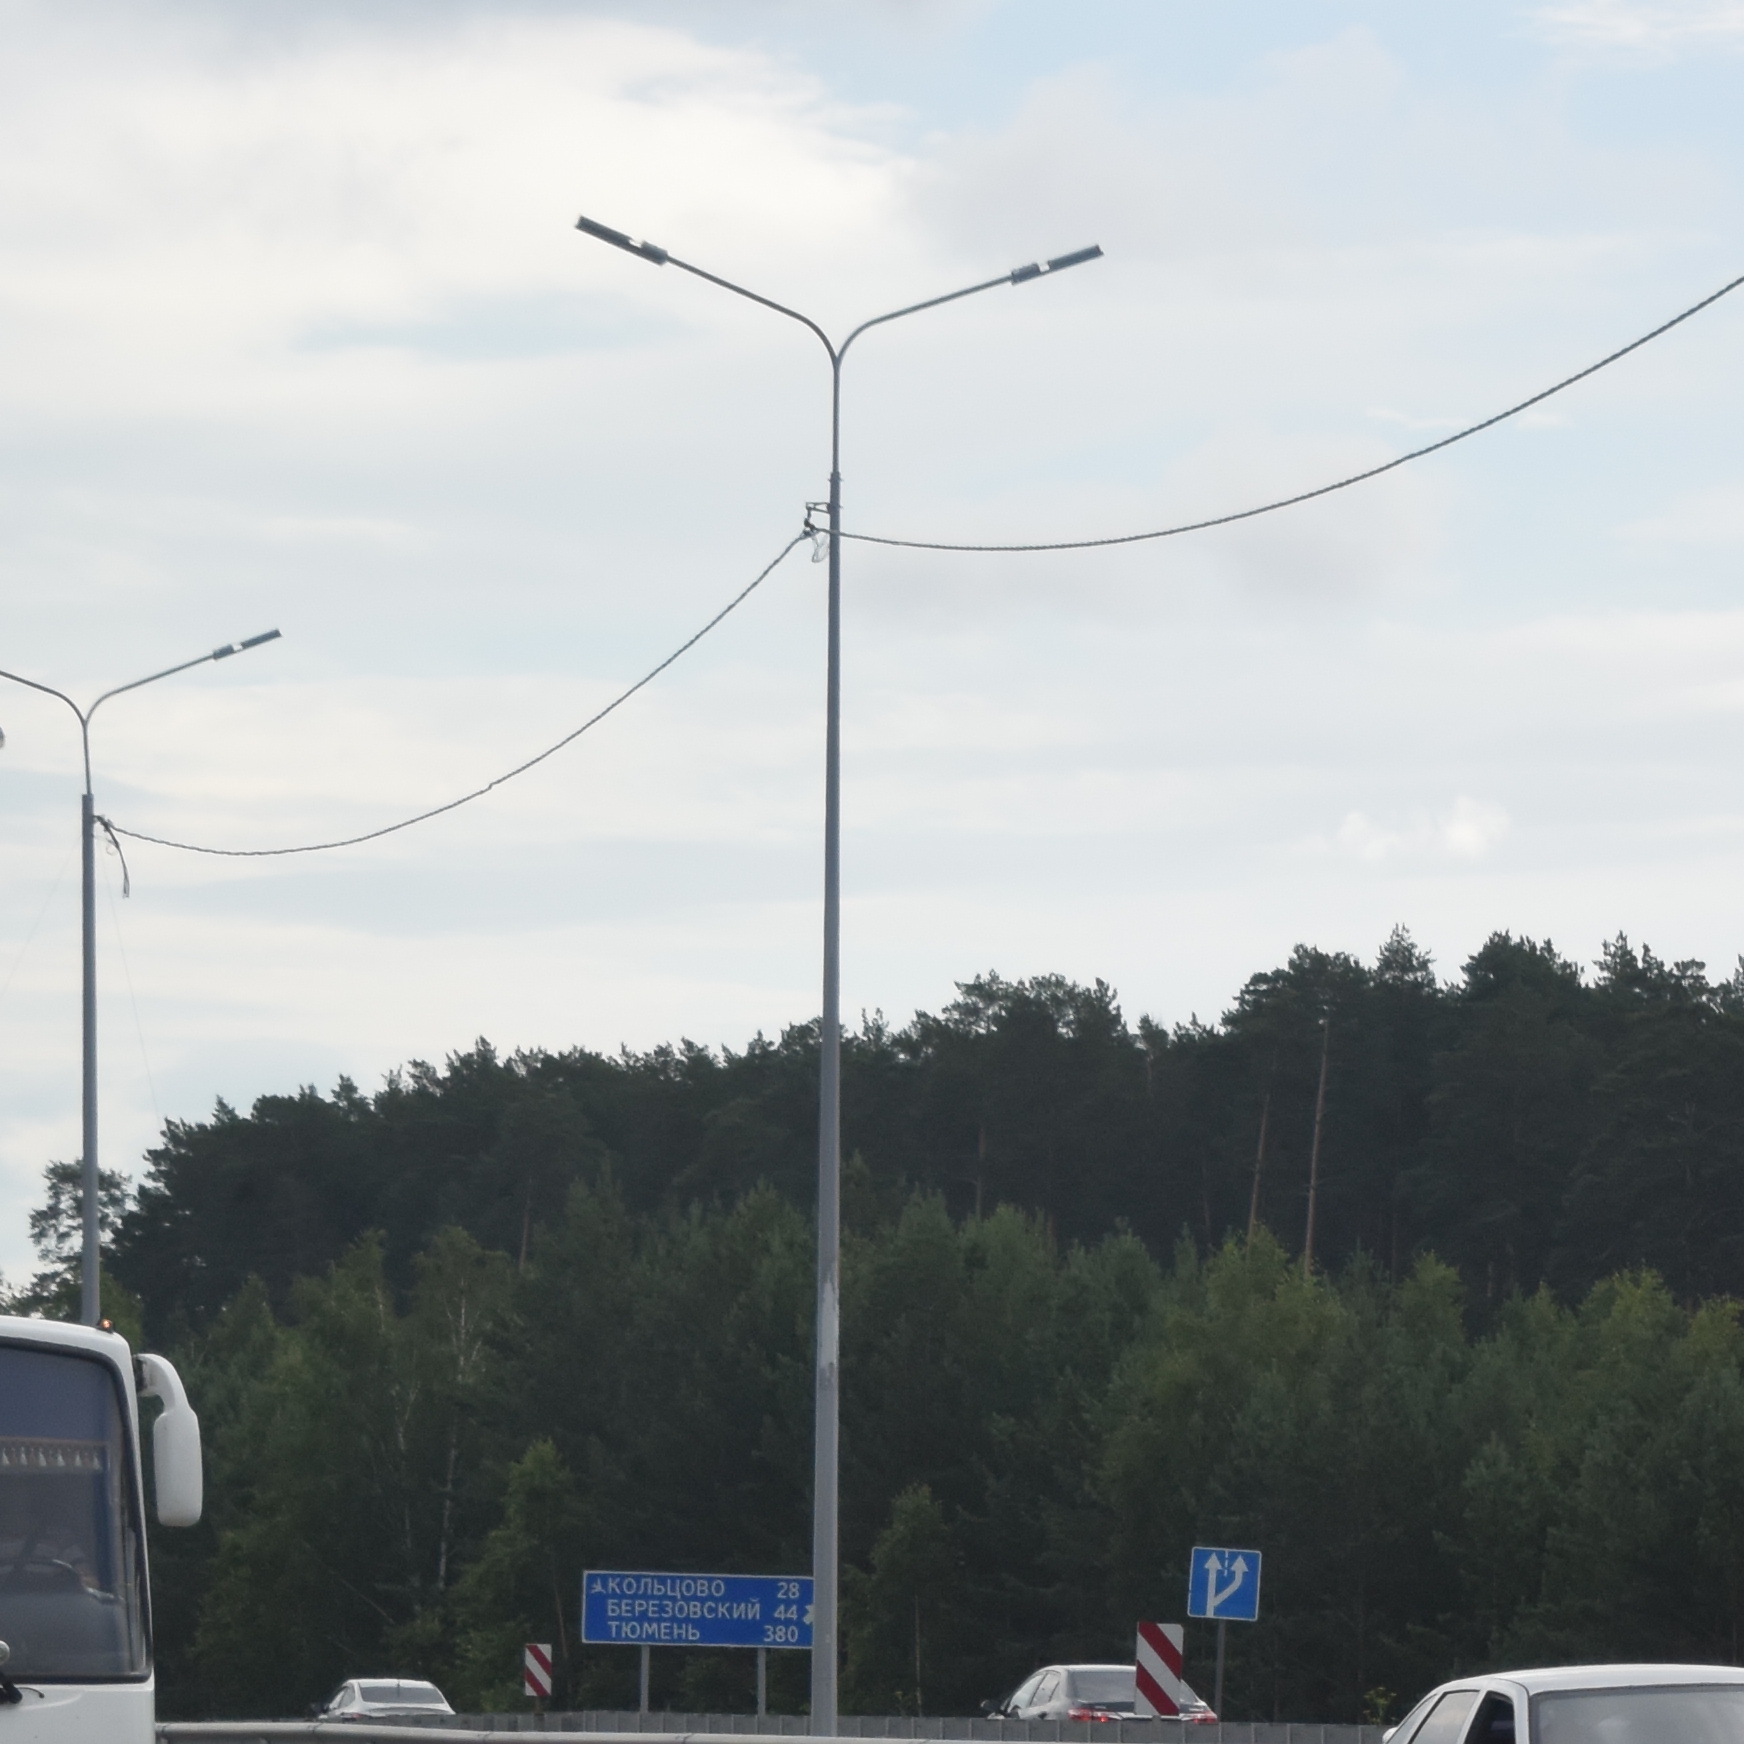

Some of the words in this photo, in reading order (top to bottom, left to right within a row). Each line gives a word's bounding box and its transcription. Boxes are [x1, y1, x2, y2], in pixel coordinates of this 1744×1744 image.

[607, 1577, 726, 1599] КОЛЬЦОВО
[776, 1582, 800, 1599] 28
[607, 1596, 761, 1620] БЕРЕЗОВСКИЙ
[773, 1604, 799, 1621] 44
[607, 1621, 701, 1641] ТЮМЕНЬ
[762, 1625, 799, 1642] 380
